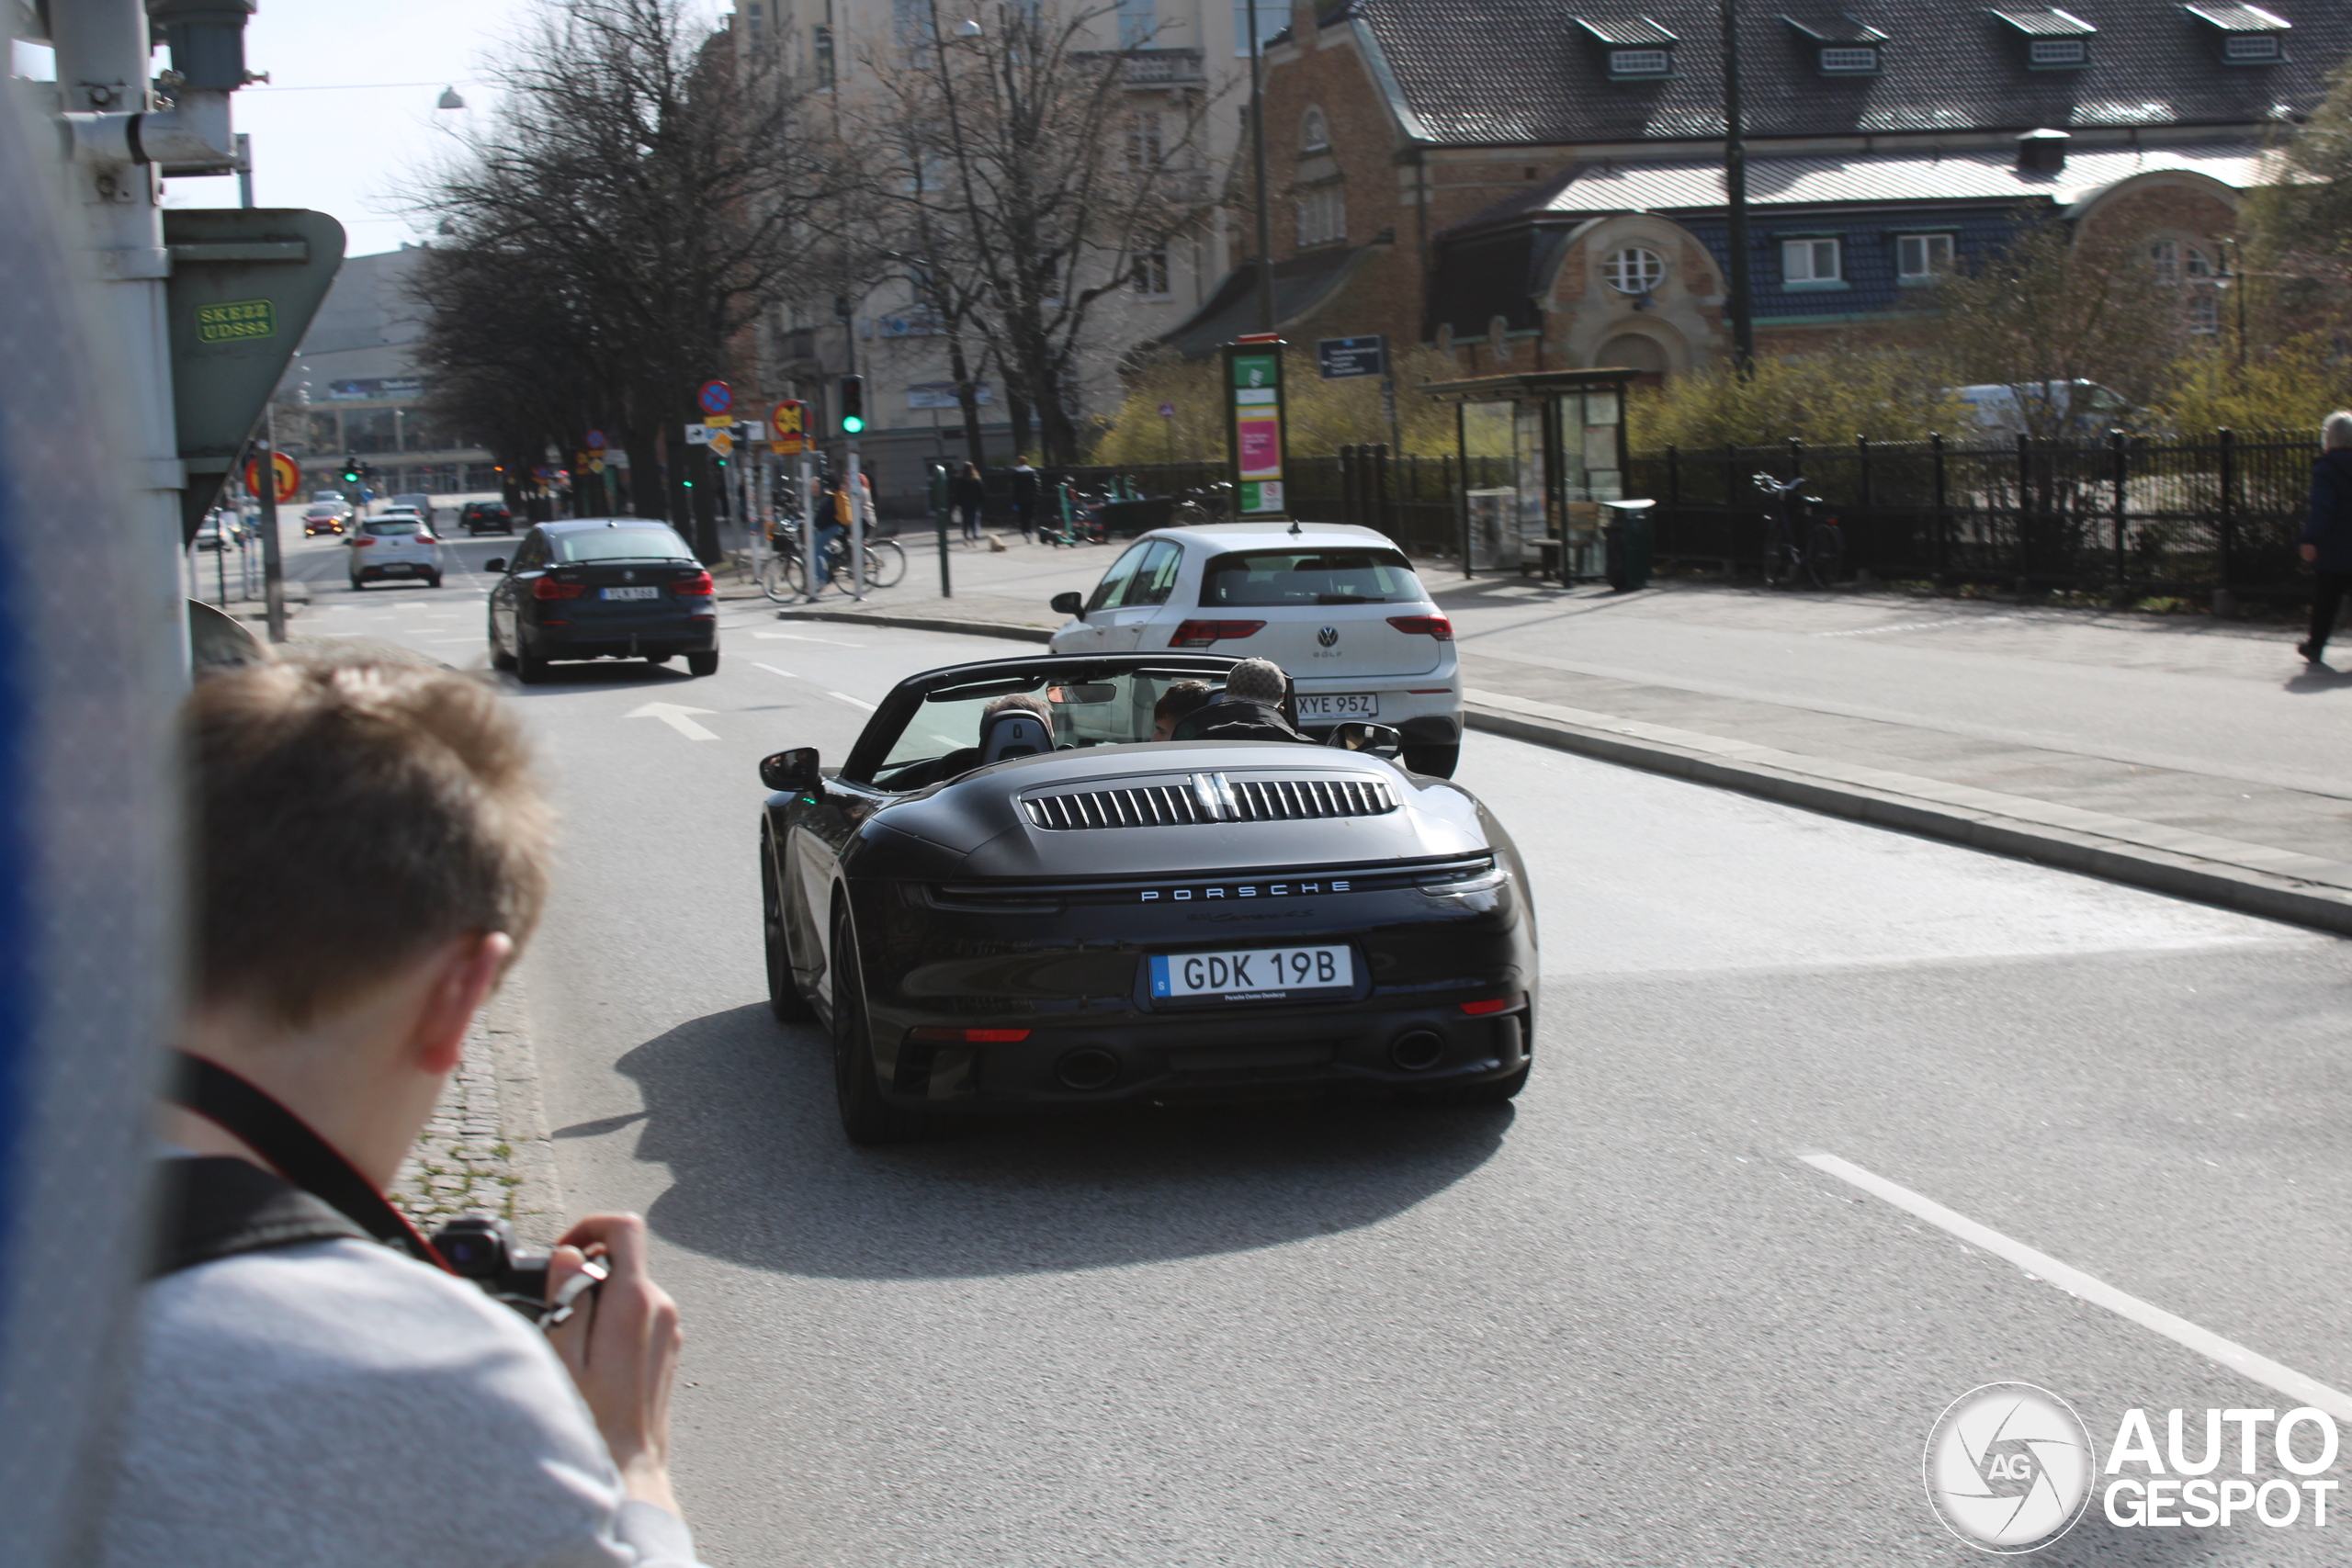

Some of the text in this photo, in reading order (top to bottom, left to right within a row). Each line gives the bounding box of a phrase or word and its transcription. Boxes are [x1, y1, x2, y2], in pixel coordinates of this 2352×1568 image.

[1298, 696, 1370, 714] XYE 95Z
[1141, 881, 1351, 901] PORSCHE
[1184, 951, 1336, 989] GDK 19B
[1158, 981, 1165, 990] S
